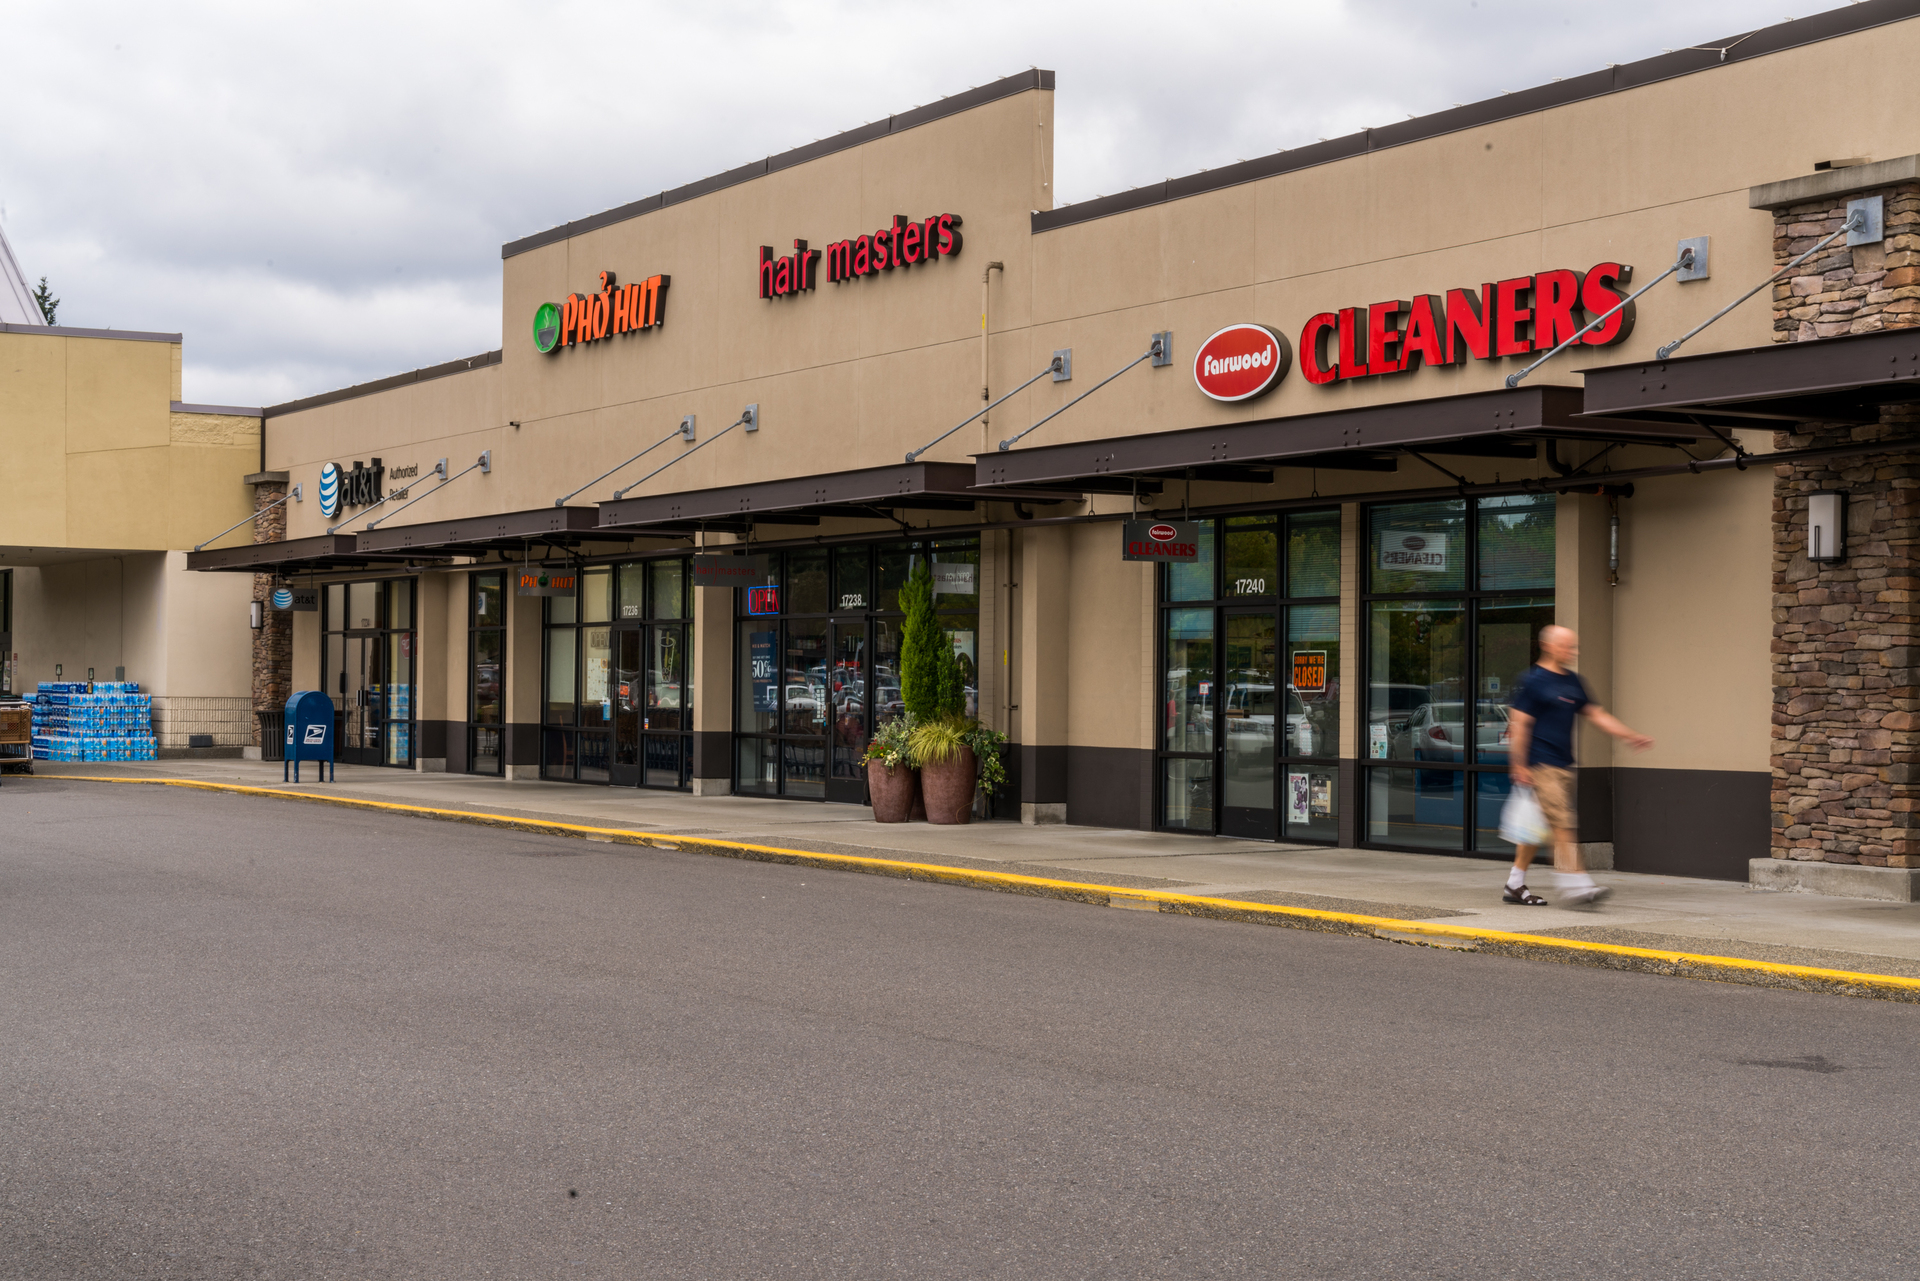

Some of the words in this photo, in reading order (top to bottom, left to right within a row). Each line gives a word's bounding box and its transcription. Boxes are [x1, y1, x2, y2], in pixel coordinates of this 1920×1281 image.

[760, 239, 820, 299] hair
[827, 213, 962, 283] masters
[613, 274, 670, 334] HUT
[1300, 262, 1634, 386] CLEANERS
[389, 463, 418, 480] Authorized
[1128, 541, 1196, 557] CLEANERS
[696, 564, 714, 575] hair
[718, 566, 756, 577] masters
[551, 576, 575, 589] HUT
[1235, 578, 1265, 594] 17240
[294, 594, 315, 605] at&t
[749, 589, 779, 614] OPEN
[841, 593, 862, 607] 17238
[623, 605, 639, 616] 17236
[591, 632, 609, 647] OPEN
[1294, 666, 1324, 687] CLOSED
